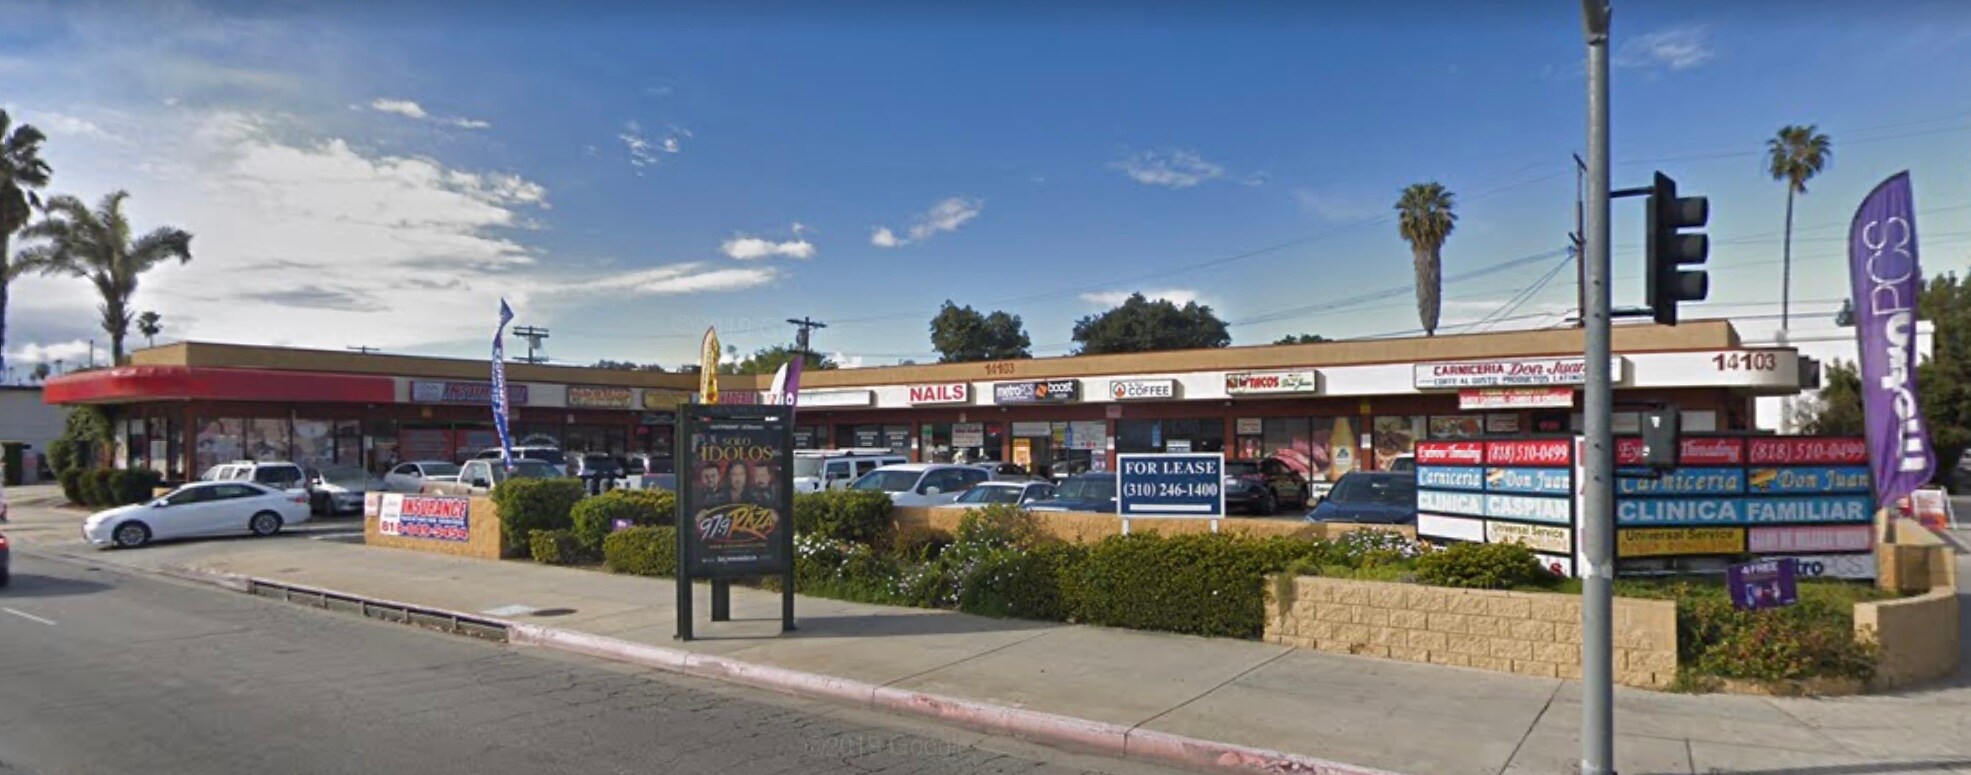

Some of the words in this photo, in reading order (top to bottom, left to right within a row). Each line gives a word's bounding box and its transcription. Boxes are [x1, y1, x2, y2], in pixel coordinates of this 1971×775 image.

[1862, 216, 1928, 473] metroPCS
[984, 363, 1015, 375] 14103
[1434, 364, 1504, 376] CARNICERIA
[1508, 362, 1544, 375] Don
[1712, 353, 1777, 371] 14103
[1048, 381, 1073, 393] boost
[1502, 375, 1549, 385] PRODUCTOS
[1553, 374, 1585, 382] LATINO
[909, 384, 965, 401] NAILS
[996, 383, 1034, 397] metroPCS
[1128, 385, 1169, 396] COFFEE
[702, 445, 774, 461] IDOLOS
[1488, 442, 1514, 462] (818)
[1516, 444, 1568, 461] 510-0499
[1750, 442, 1792, 463] (818)
[1797, 443, 1866, 461] 510-0499
[1125, 462, 1158, 475] FOR
[1163, 461, 1216, 475] LEASE
[1419, 468, 1481, 487] Carniceria
[1505, 471, 1532, 487] Don
[1534, 471, 1570, 492] Juan
[1619, 469, 1738, 494] Carniceria
[1777, 470, 1817, 489] Don
[1822, 469, 1869, 491] Juan
[1123, 482, 1156, 497] (310)
[1159, 482, 1218, 497] 246-1400
[402, 497, 467, 518] INSURANCE
[1418, 493, 1481, 512] CLINICA
[1487, 497, 1569, 520] CASPIAN
[1617, 500, 1738, 521] CLINICA
[1746, 501, 1864, 521] FAMILIAR
[700, 513, 731, 539] 97.9
[1625, 528, 1685, 541] Universal
[1687, 528, 1734, 541] Service
[1794, 556, 1865, 576] troPCS
